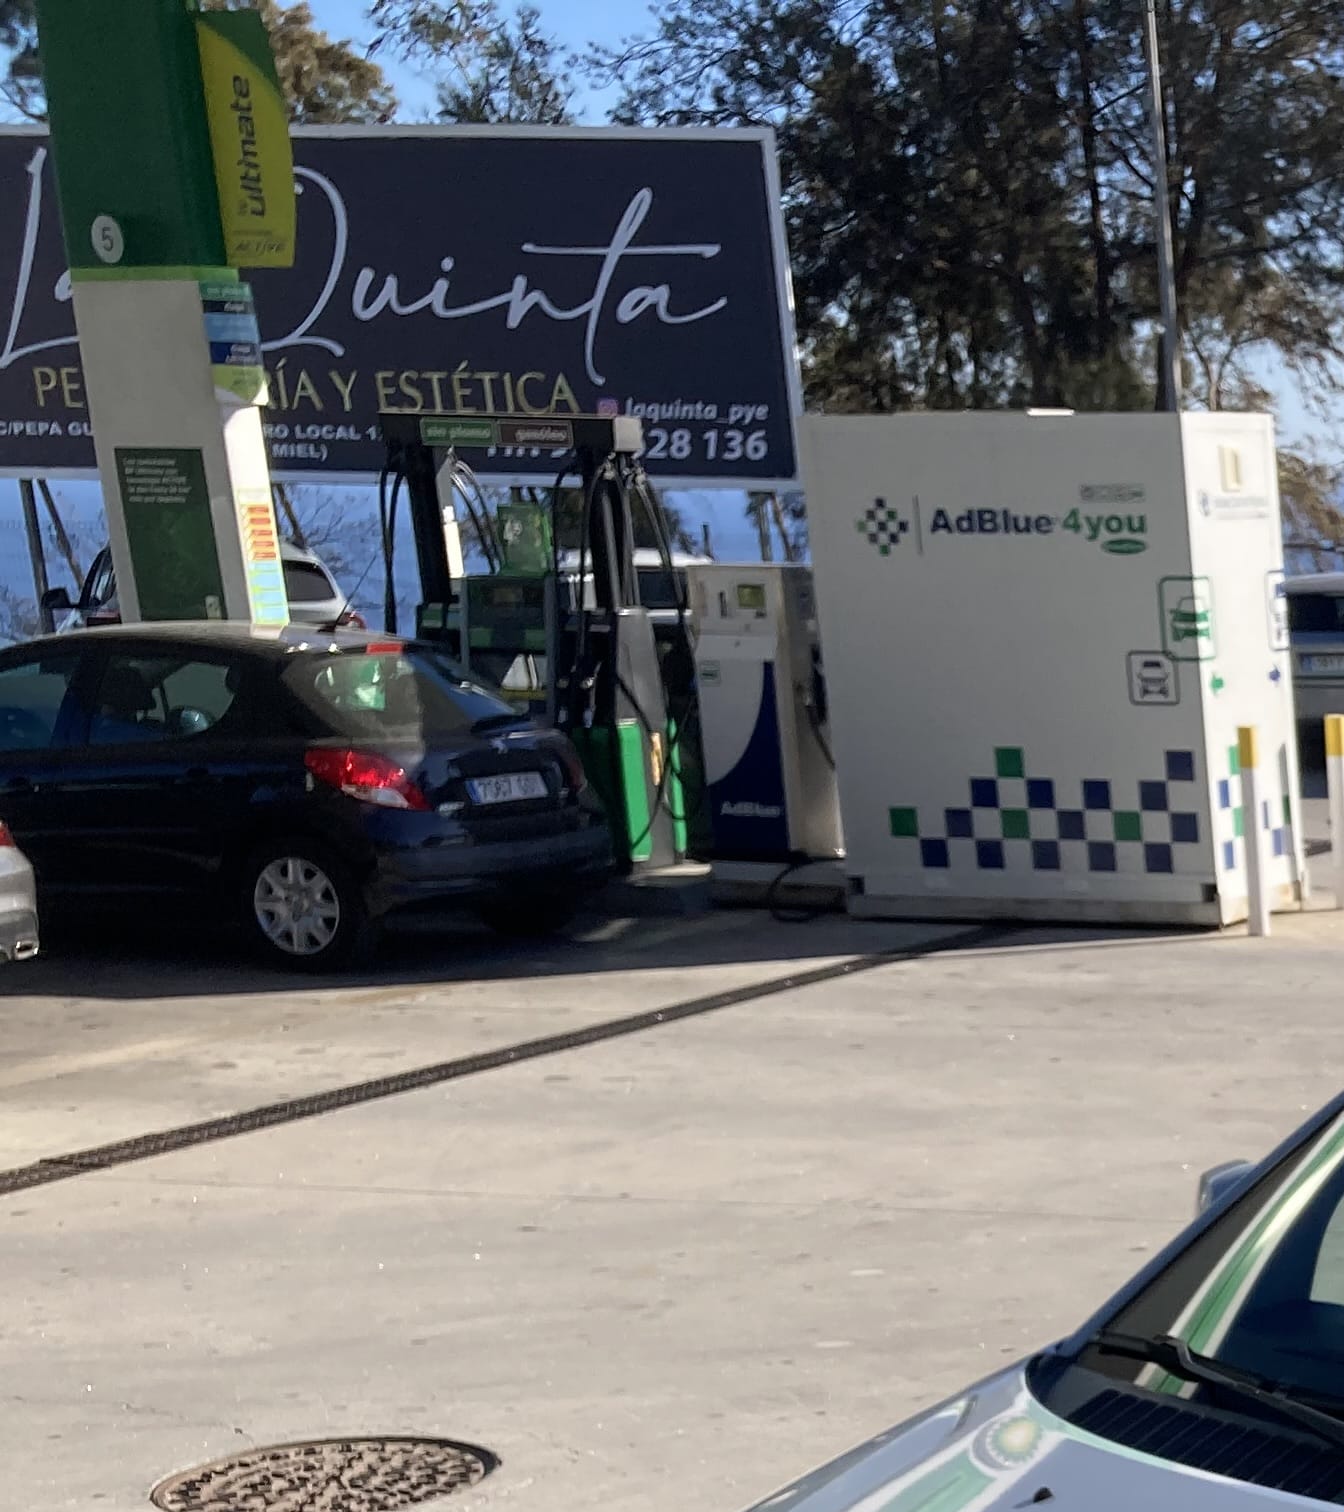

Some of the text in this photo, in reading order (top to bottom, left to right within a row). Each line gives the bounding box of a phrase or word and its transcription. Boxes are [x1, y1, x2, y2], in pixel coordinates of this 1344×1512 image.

[230, 75, 266, 217] ultimate
[101, 226, 115, 252] 5
[329, 368, 357, 412] Y
[376, 358, 580, 412] ESTÉTICA
[625, 396, 769, 425] laquinta_pye
[295, 423, 361, 441] LOCAL
[632, 427, 769, 460] 28 136
[273, 443, 328, 461] MIEL)
[930, 506, 1148, 541] AdBlue 4you
